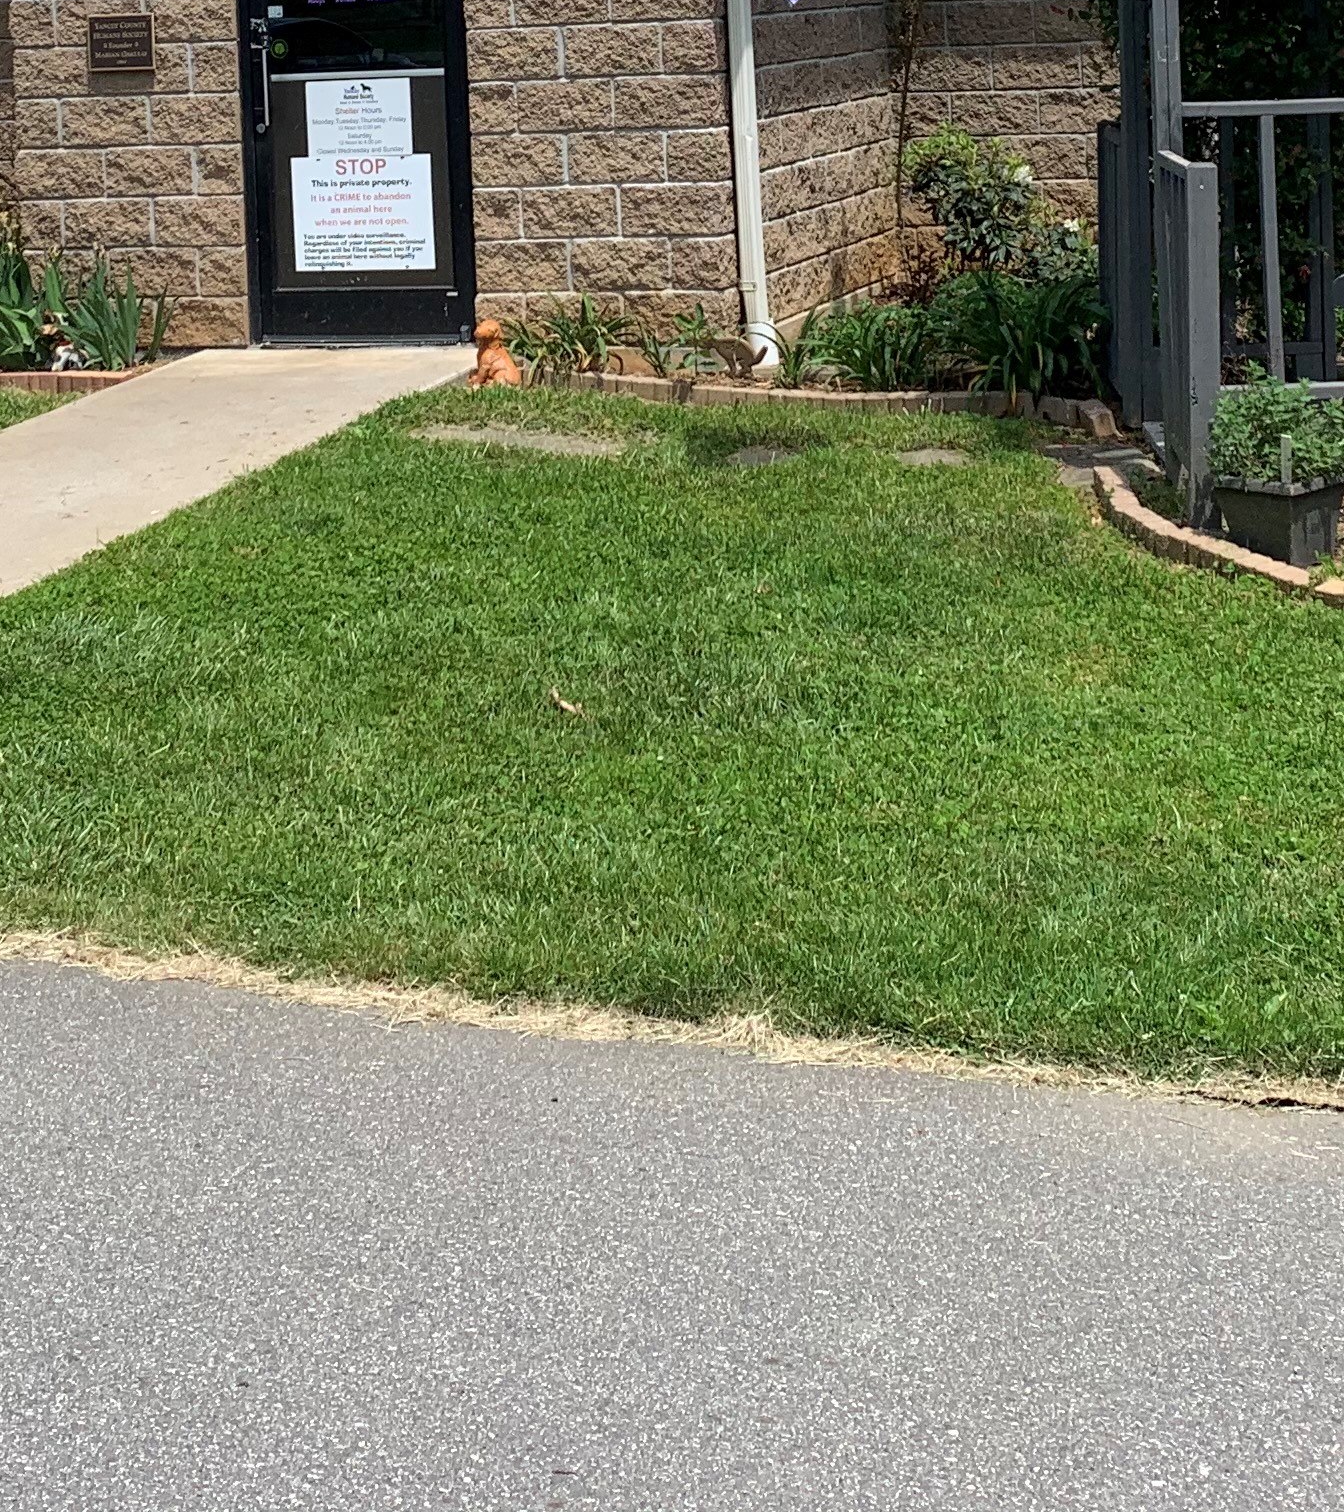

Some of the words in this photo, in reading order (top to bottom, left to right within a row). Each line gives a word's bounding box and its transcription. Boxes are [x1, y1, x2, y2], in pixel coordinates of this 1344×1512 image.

[335, 158, 387, 175] STOP
[311, 179, 328, 187] This
[330, 179, 338, 187] is
[339, 179, 370, 188] private
[372, 178, 412, 187] property.
[310, 194, 317, 202] It
[318, 194, 325, 202] is
[334, 193, 360, 201] CRIME
[362, 193, 372, 201] to
[373, 192, 411, 200] abandon
[342, 205, 371, 213] animal
[373, 205, 392, 213] here
[315, 218, 338, 226] when
[385, 218, 409, 227] open.
